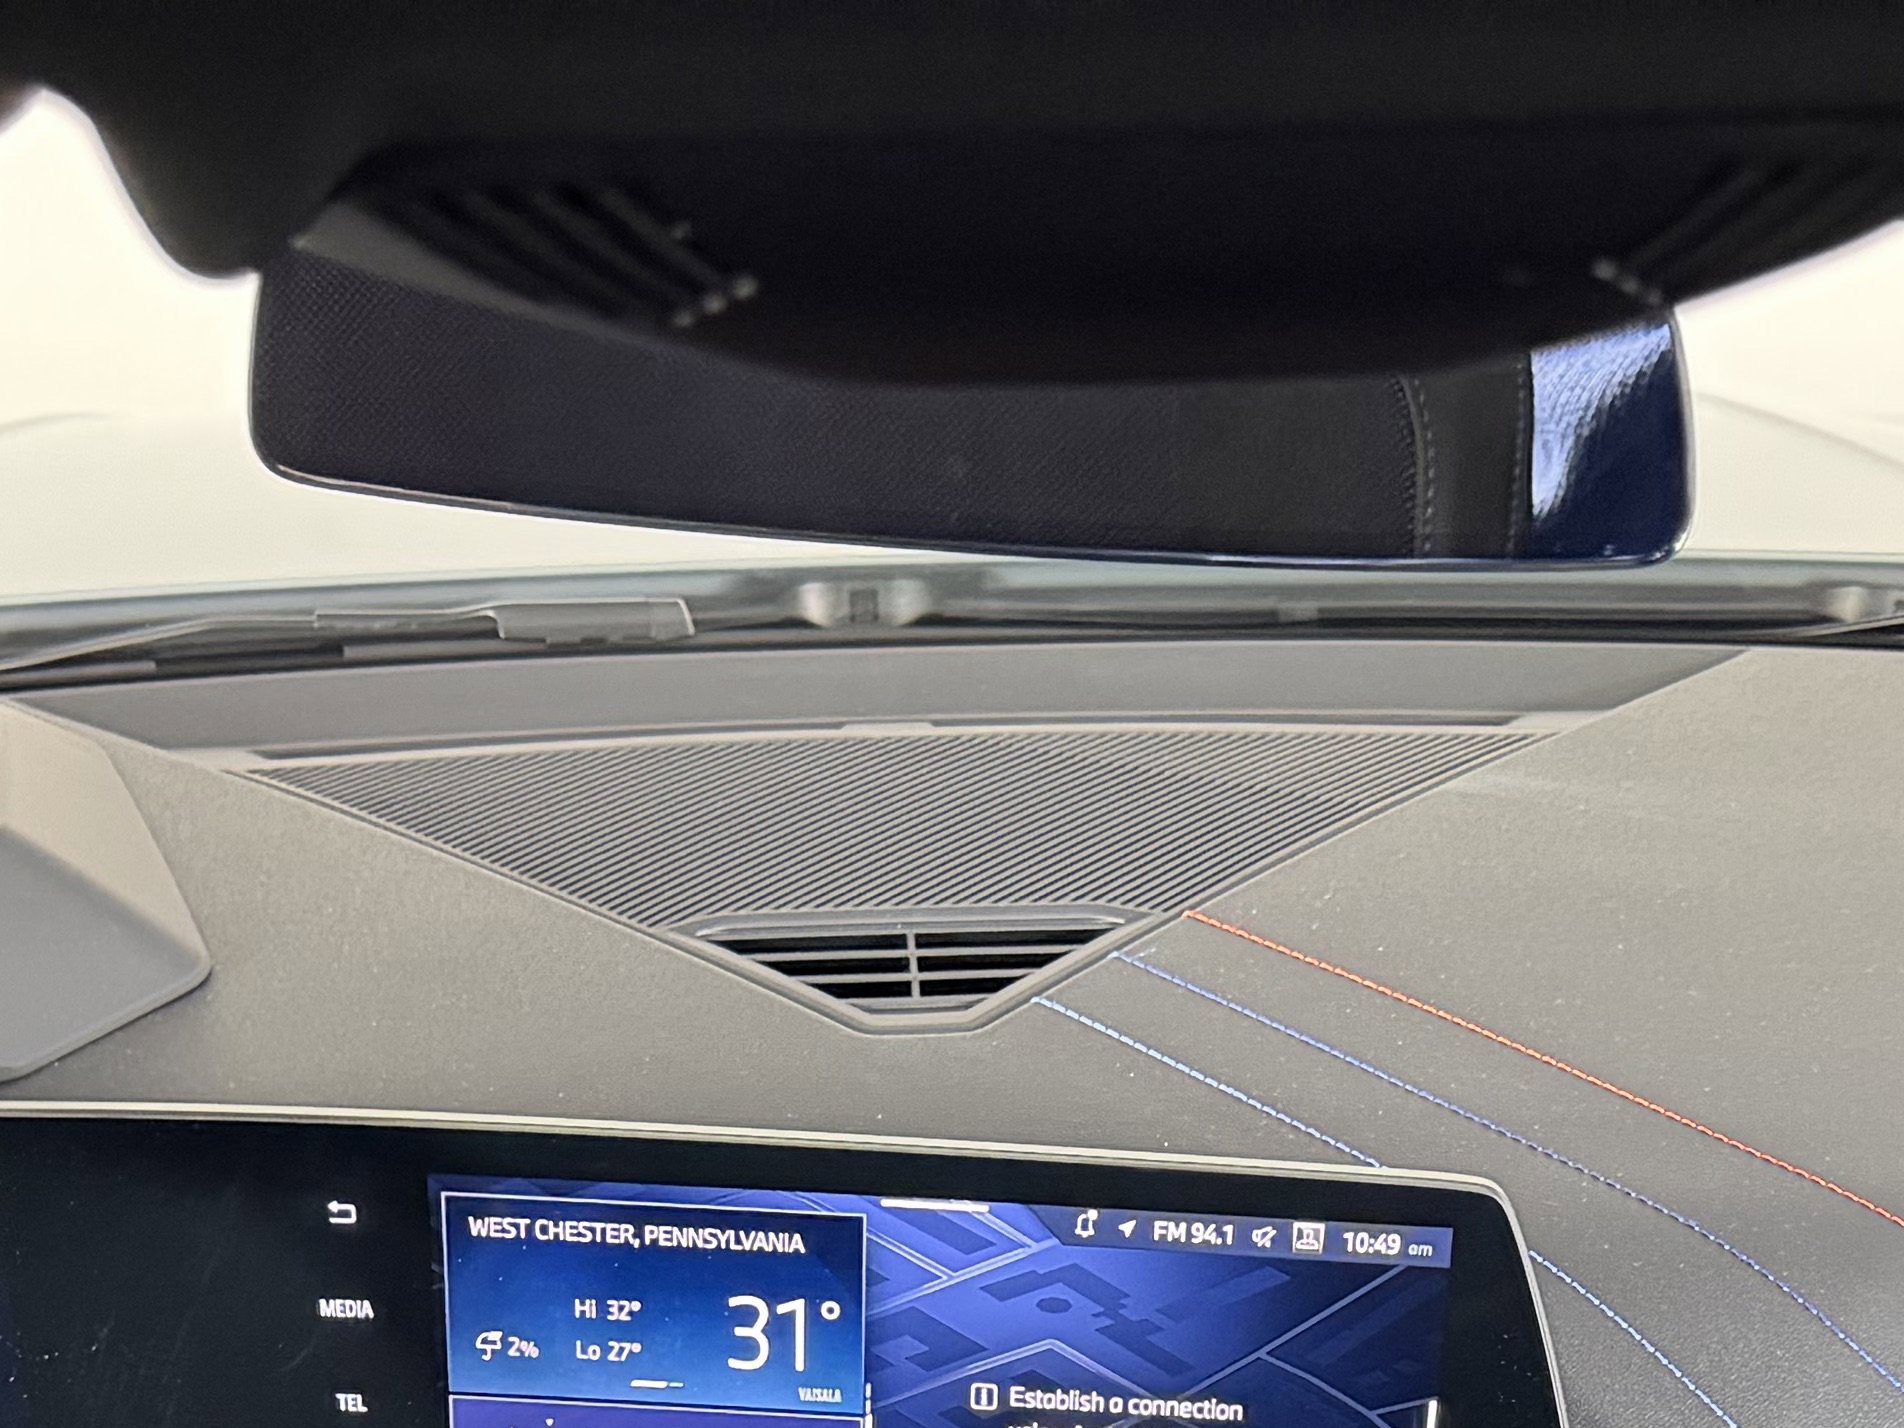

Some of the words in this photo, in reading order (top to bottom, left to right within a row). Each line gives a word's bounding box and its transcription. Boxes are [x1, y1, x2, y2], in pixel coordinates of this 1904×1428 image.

[467, 1215, 531, 1239] WEST
[534, 1218, 641, 1249] CHESTER,
[644, 1224, 807, 1255] PENNSYLVANIA
[1152, 1221, 1187, 1244] FM
[1190, 1223, 1235, 1246] 94.1
[1342, 1231, 1402, 1256] 10:49
[1407, 1241, 1433, 1258] am
[318, 1298, 375, 1320] MEDIA
[573, 1298, 597, 1319] Hi
[606, 1299, 642, 1322] 32°
[726, 1293, 842, 1372] 31°
[507, 1336, 540, 1359] 2%
[575, 1339, 601, 1361] Lo
[607, 1341, 642, 1362] 27°
[335, 1393, 369, 1413] TEL
[1009, 1384, 1105, 1414] Establish
[1109, 1397, 1124, 1415] a
[1127, 1395, 1243, 1421] connection
